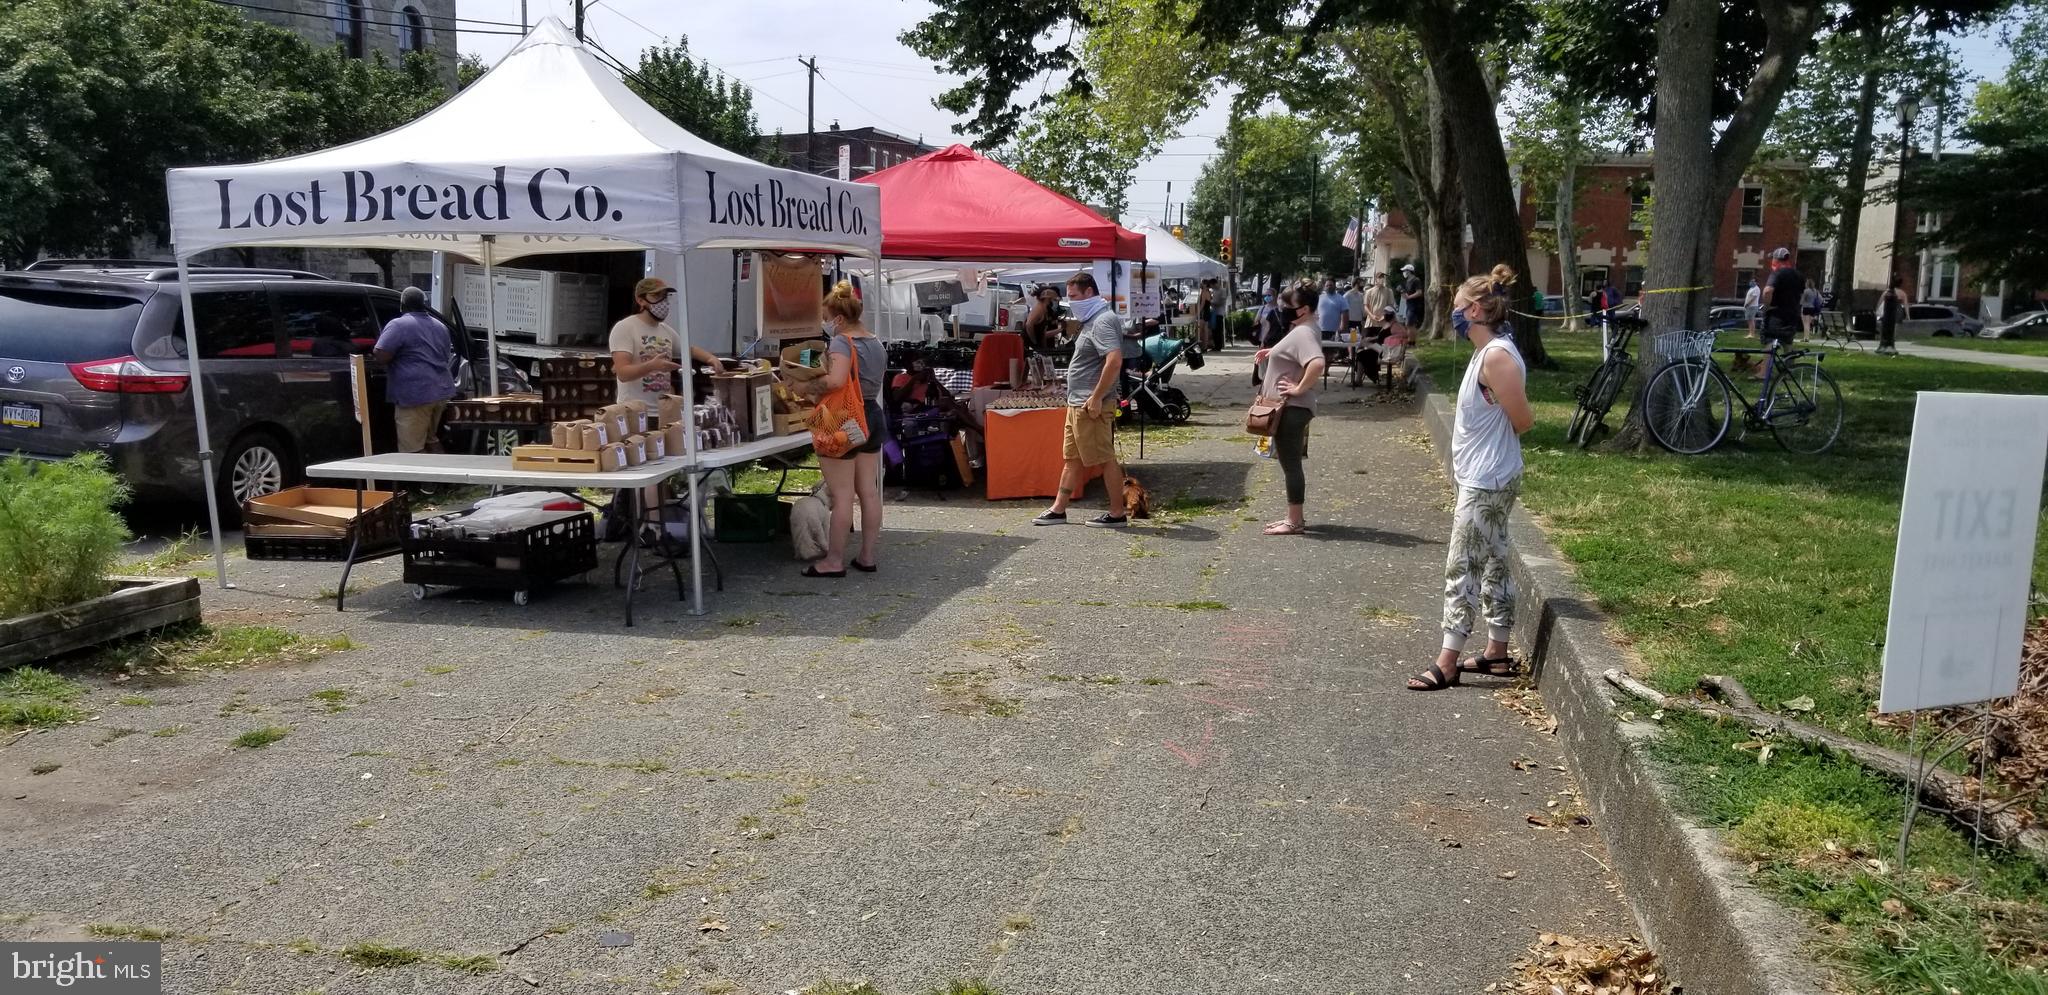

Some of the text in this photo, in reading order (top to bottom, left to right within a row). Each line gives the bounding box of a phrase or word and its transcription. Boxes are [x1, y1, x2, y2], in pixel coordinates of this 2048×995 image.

[215, 165, 623, 230] Lost Bread Co.
[705, 170, 868, 236] Lost Bread Co.
